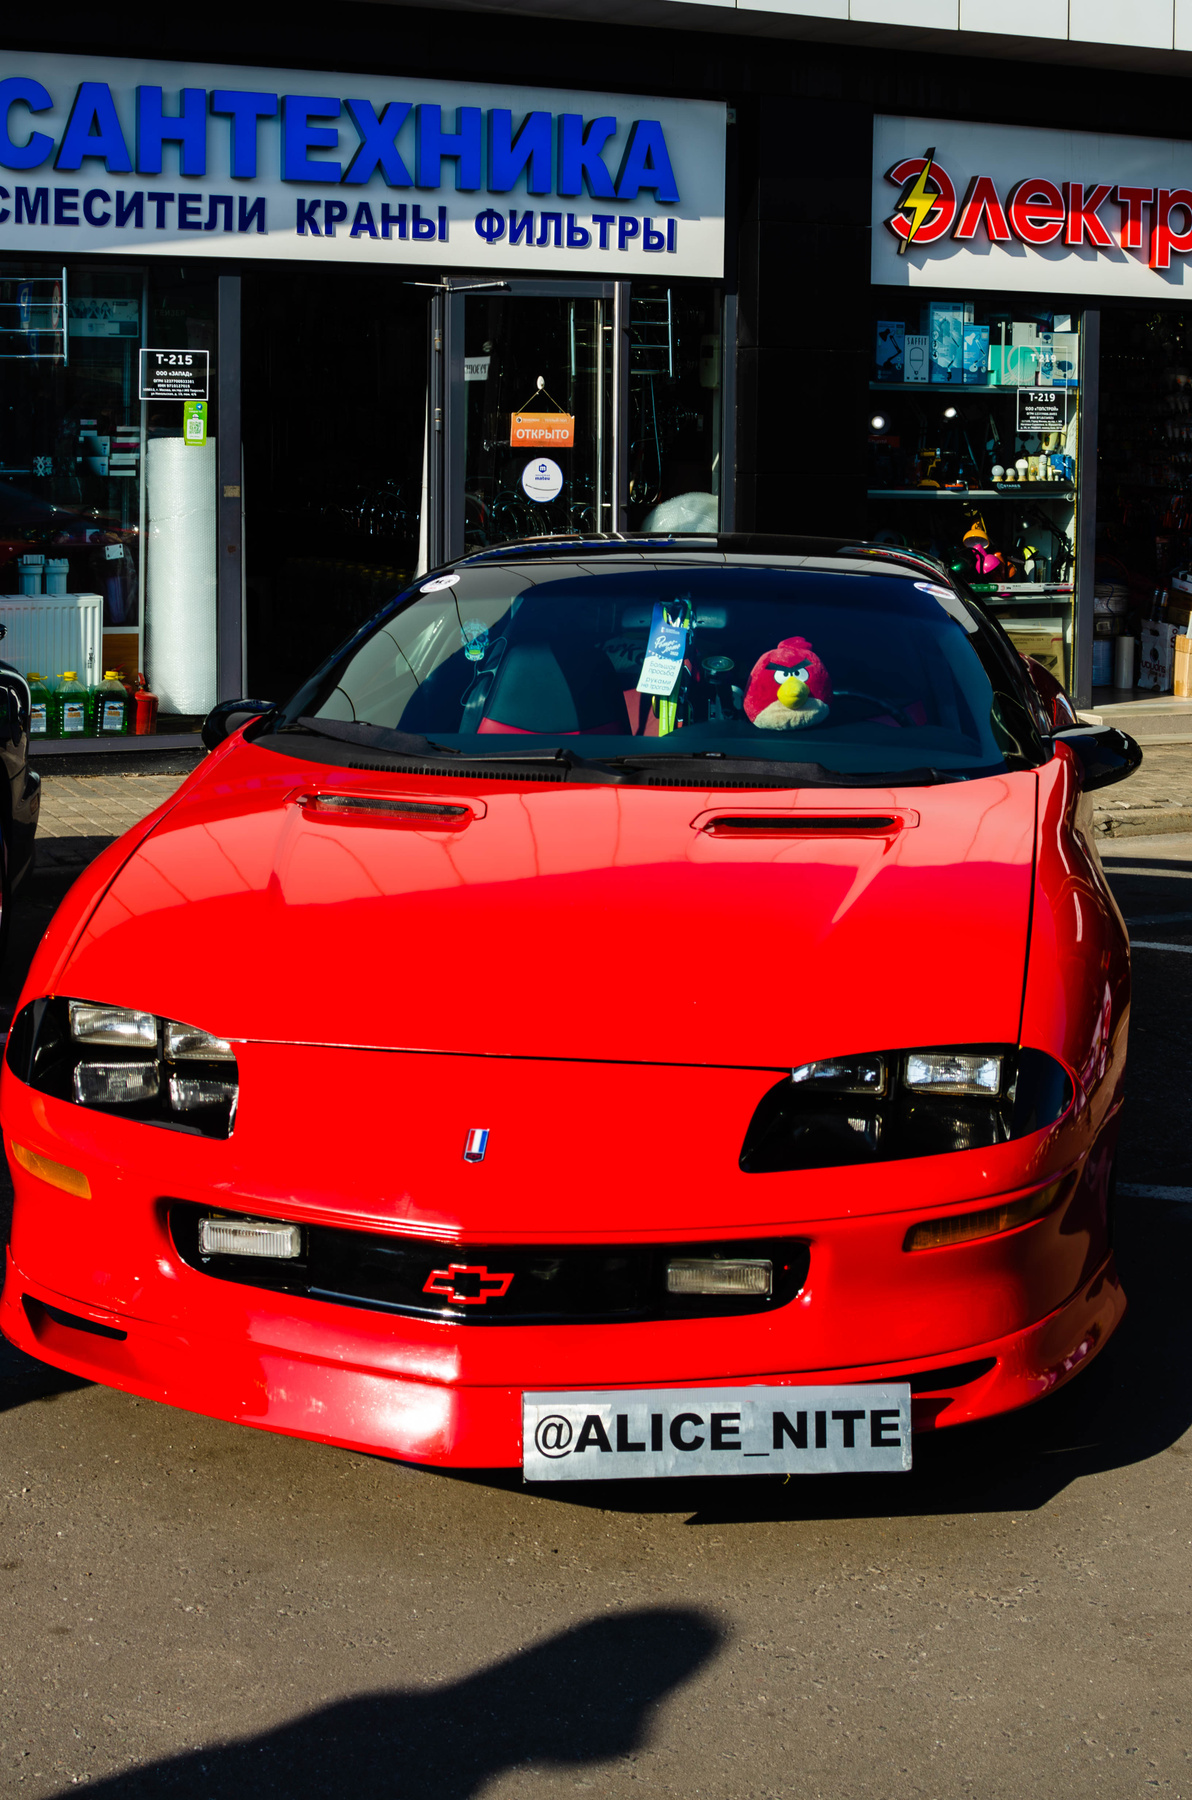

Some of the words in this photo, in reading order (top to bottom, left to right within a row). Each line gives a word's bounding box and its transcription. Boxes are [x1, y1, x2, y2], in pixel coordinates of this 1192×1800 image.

[0, 76, 681, 203] САНТЕХНИКА
[883, 156, 1192, 269] Электр
[296, 198, 449, 242] КРАНЫ
[474, 207, 677, 253] ФИЛЬТРЫ
[907, 337, 927, 346] SAFFIT
[155, 353, 193, 366] Т-215
[1030, 353, 1057, 363] Т219
[168, 370, 193, 378] «ЗАПАД»
[1028, 392, 1056, 402] Т-219
[516, 428, 570, 440] ОТКРЫТО
[534, 1408, 902, 1459] @ALICE_NITE
